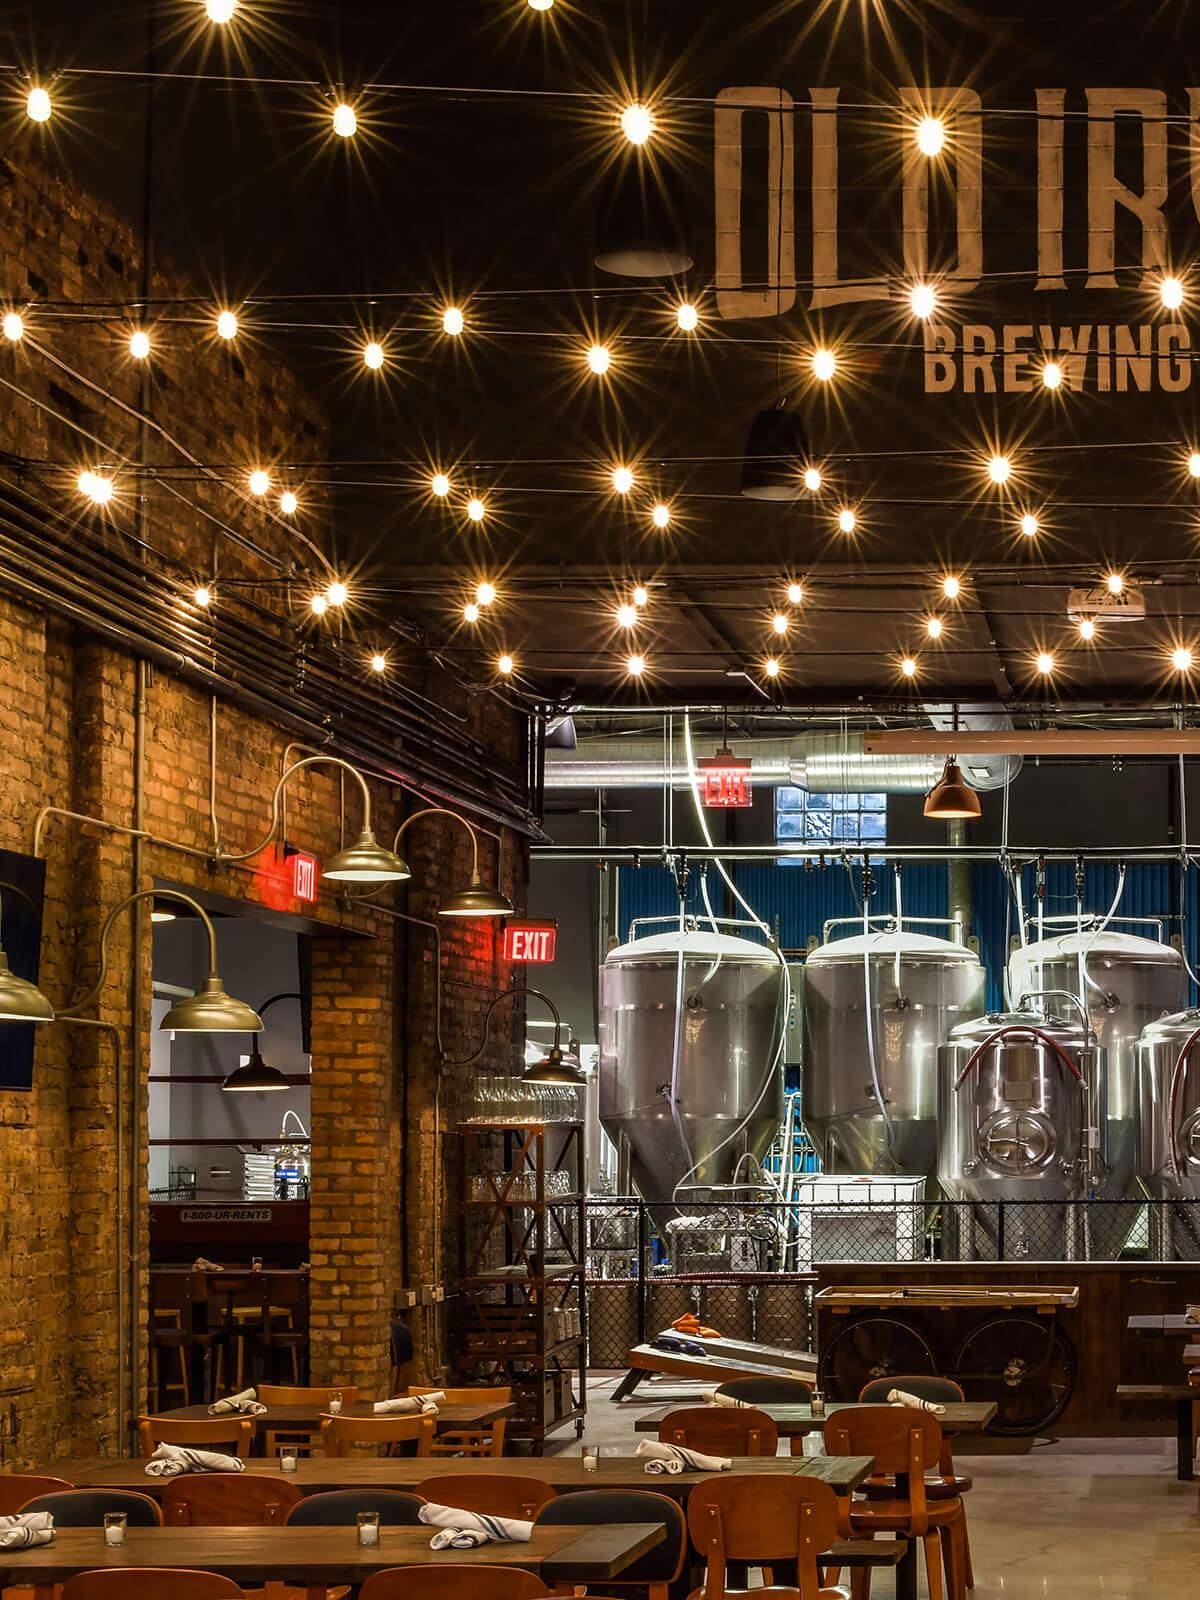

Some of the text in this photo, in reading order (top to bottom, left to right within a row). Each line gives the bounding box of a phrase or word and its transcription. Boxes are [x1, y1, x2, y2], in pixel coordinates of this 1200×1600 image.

[714, 86, 983, 319] OLD
[923, 323, 1192, 393] BREWING
[297, 859, 312, 898] EXIT
[512, 931, 549, 960] EXIT
[183, 1210, 269, 1220] 1-800-UR-RENTS
